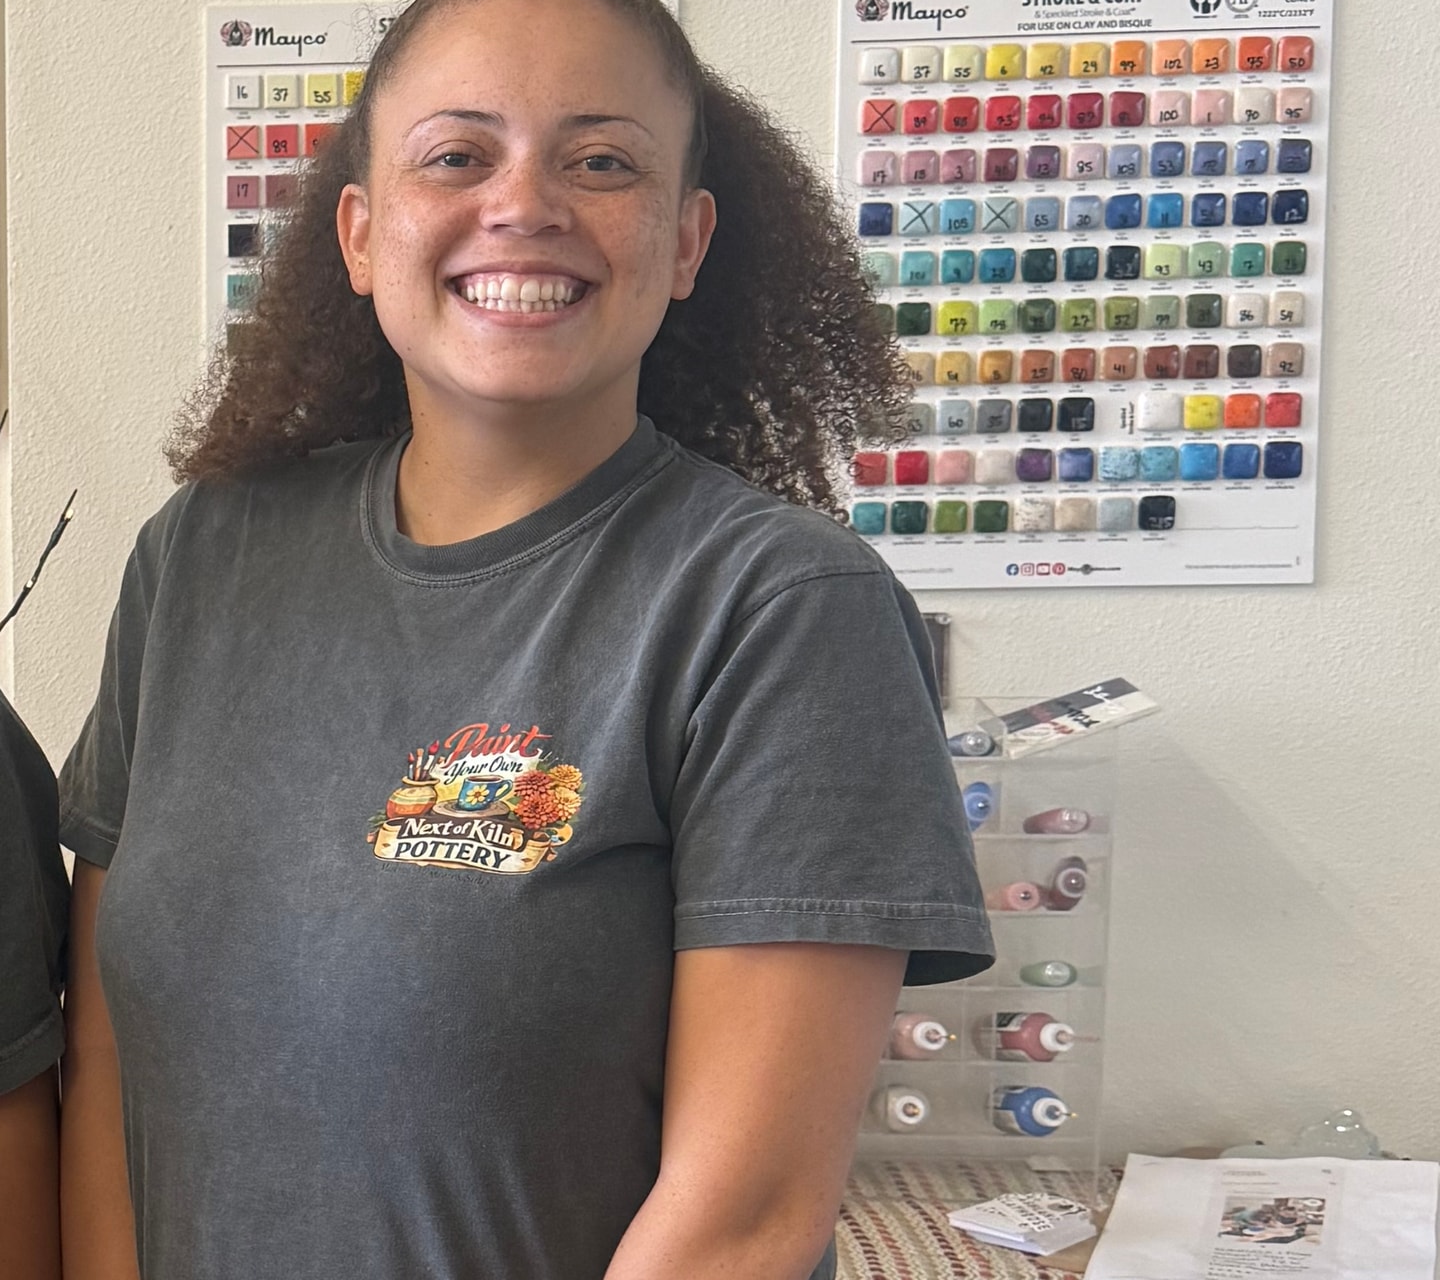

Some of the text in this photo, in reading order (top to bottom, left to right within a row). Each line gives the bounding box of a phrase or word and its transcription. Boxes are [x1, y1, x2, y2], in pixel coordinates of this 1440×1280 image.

[891, 0, 967, 31] Mayco
[1017, 18, 1153, 31] FOR USE ON CLAY AND BISQUE
[254, 27, 327, 57] Mayco
[1164, 58, 1183, 69] 102
[1288, 57, 1305, 68] 50
[913, 66, 930, 78] 37
[954, 67, 971, 78] 55
[1000, 65, 1008, 75] 6
[236, 84, 249, 100] 16
[273, 87, 288, 102] 37
[313, 90, 331, 103] 55
[1160, 110, 1179, 122] 100
[272, 139, 288, 154] 89
[236, 183, 249, 198] 17
[1034, 214, 1049, 227] 65
[1154, 264, 1171, 276] 93
[1197, 259, 1213, 273] 43
[1071, 315, 1091, 327] 27
[1113, 363, 1127, 374] 41
[1278, 360, 1295, 373] 92
[947, 416, 964, 429] 60
[442, 723, 552, 768] Paint
[443, 756, 523, 785] Your Own
[402, 818, 515, 848] Next of Kiln
[394, 840, 512, 869] POTTERY
